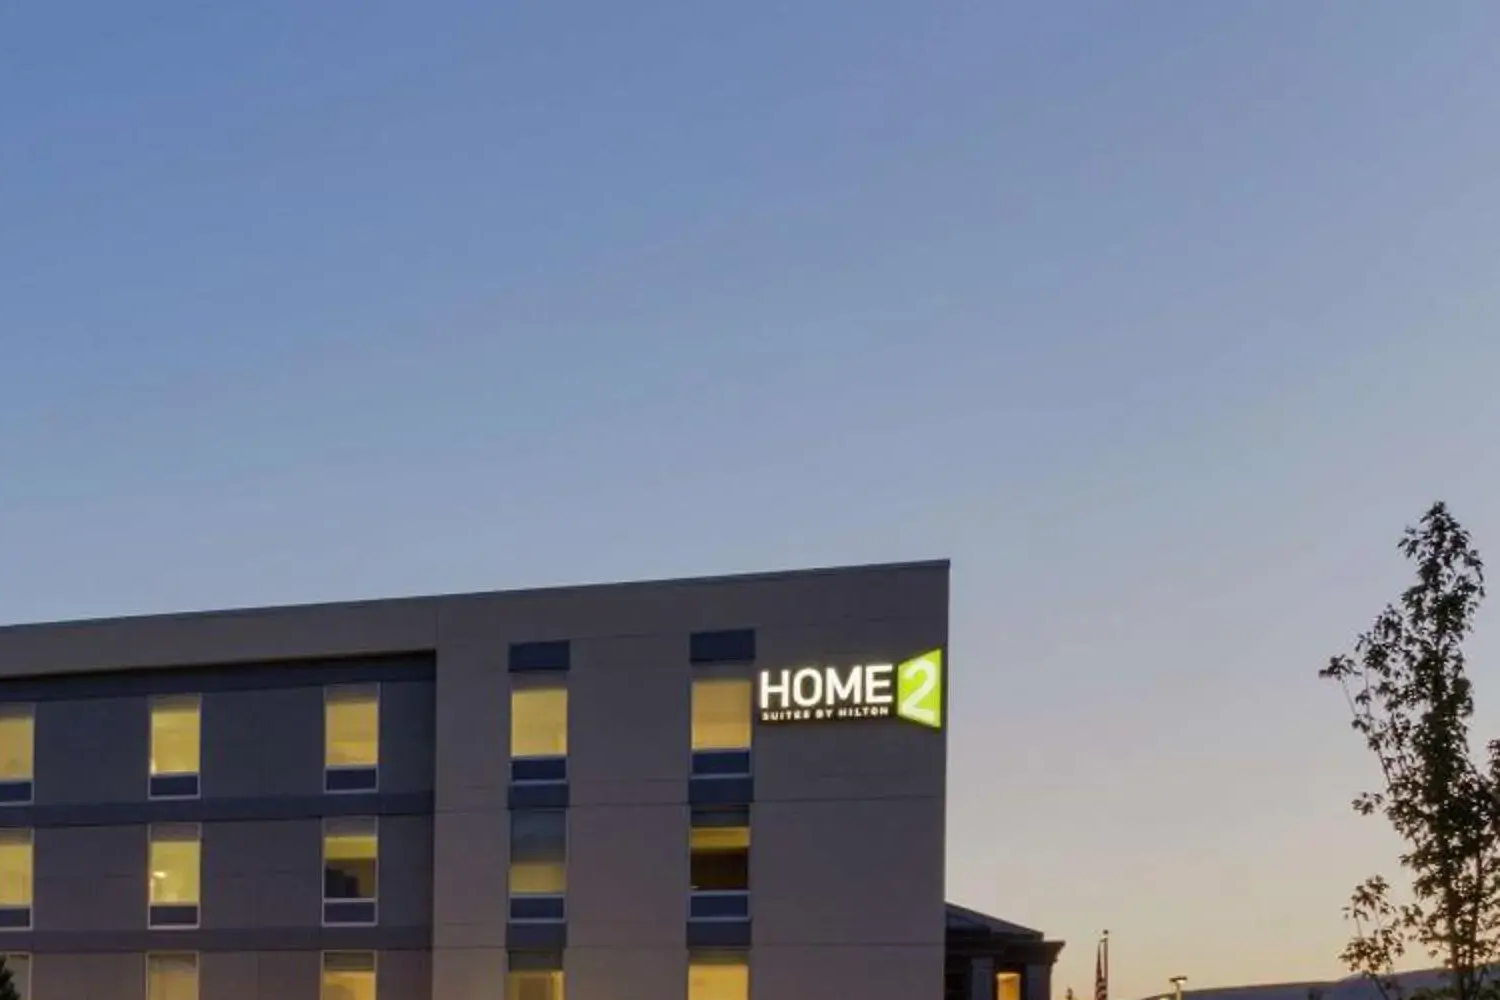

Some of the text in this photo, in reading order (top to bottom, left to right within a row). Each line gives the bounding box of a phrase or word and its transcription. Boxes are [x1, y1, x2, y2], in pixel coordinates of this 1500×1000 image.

[760, 659, 937, 726] HOME 2
[761, 705, 889, 721] SUITES BY HILTON
